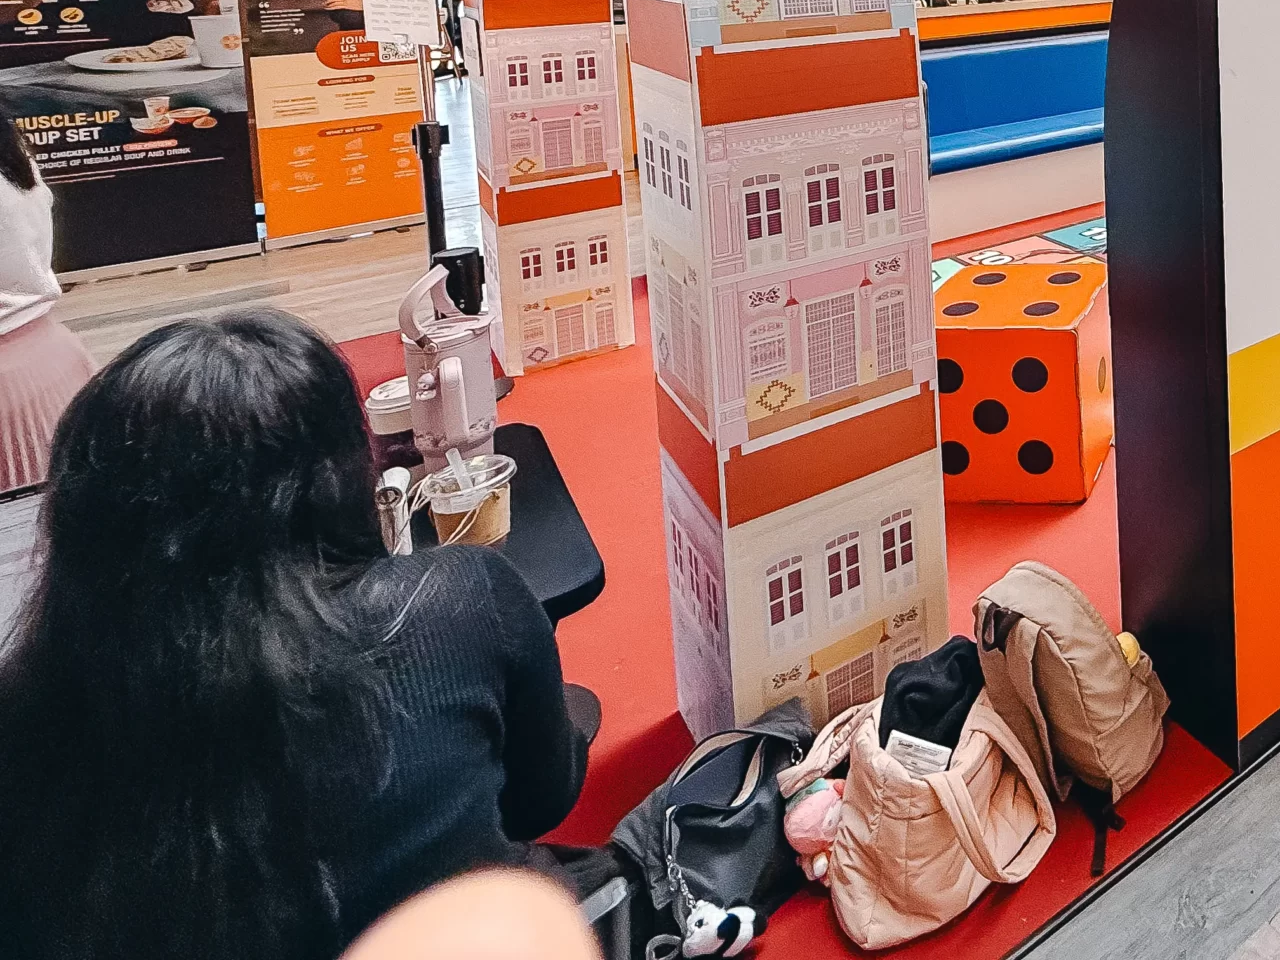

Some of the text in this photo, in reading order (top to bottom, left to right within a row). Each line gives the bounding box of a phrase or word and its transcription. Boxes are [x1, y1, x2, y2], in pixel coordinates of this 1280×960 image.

[339, 35, 368, 45] JOIN
[340, 44, 357, 53] US
[66, 126, 103, 143] SET
[50, 149, 91, 159] CHICKEN
[92, 145, 122, 155] FILLET
[123, 152, 146, 161] SOUP
[147, 150, 165, 159] AND
